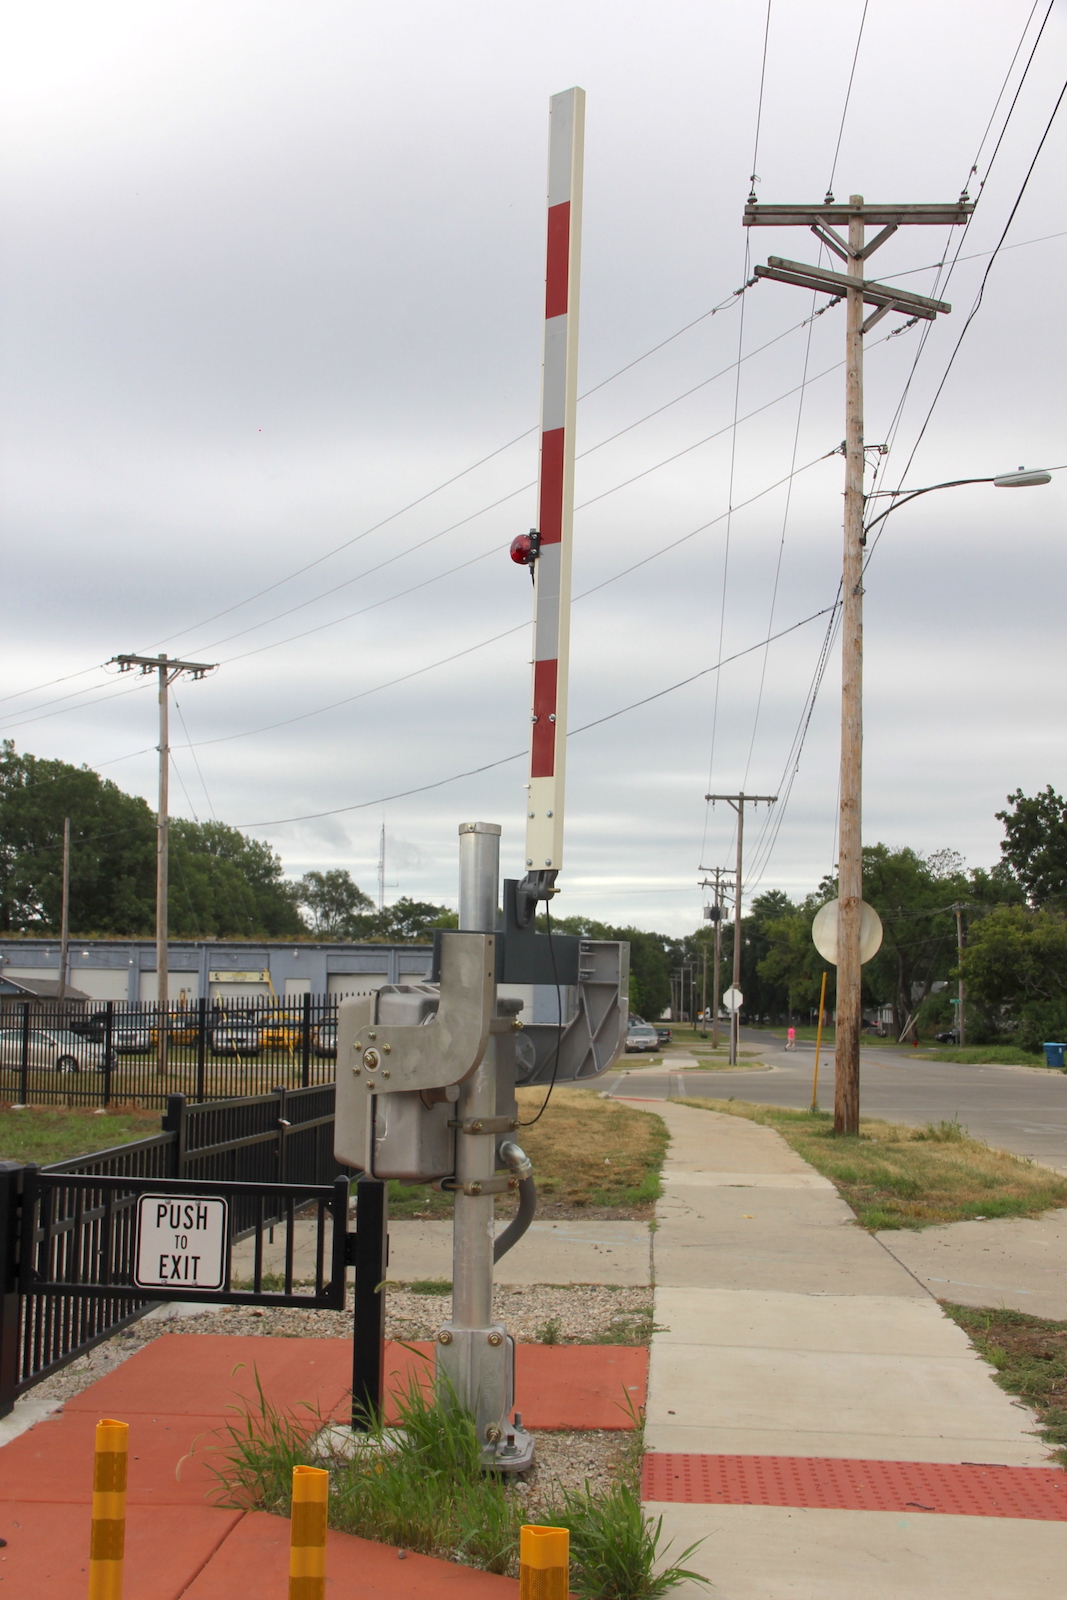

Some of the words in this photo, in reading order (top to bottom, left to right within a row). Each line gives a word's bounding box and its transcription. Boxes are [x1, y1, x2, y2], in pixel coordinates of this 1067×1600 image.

[156, 1204, 208, 1230] PUSH
[174, 1234, 188, 1250] TO
[159, 1254, 201, 1281] EXIT
